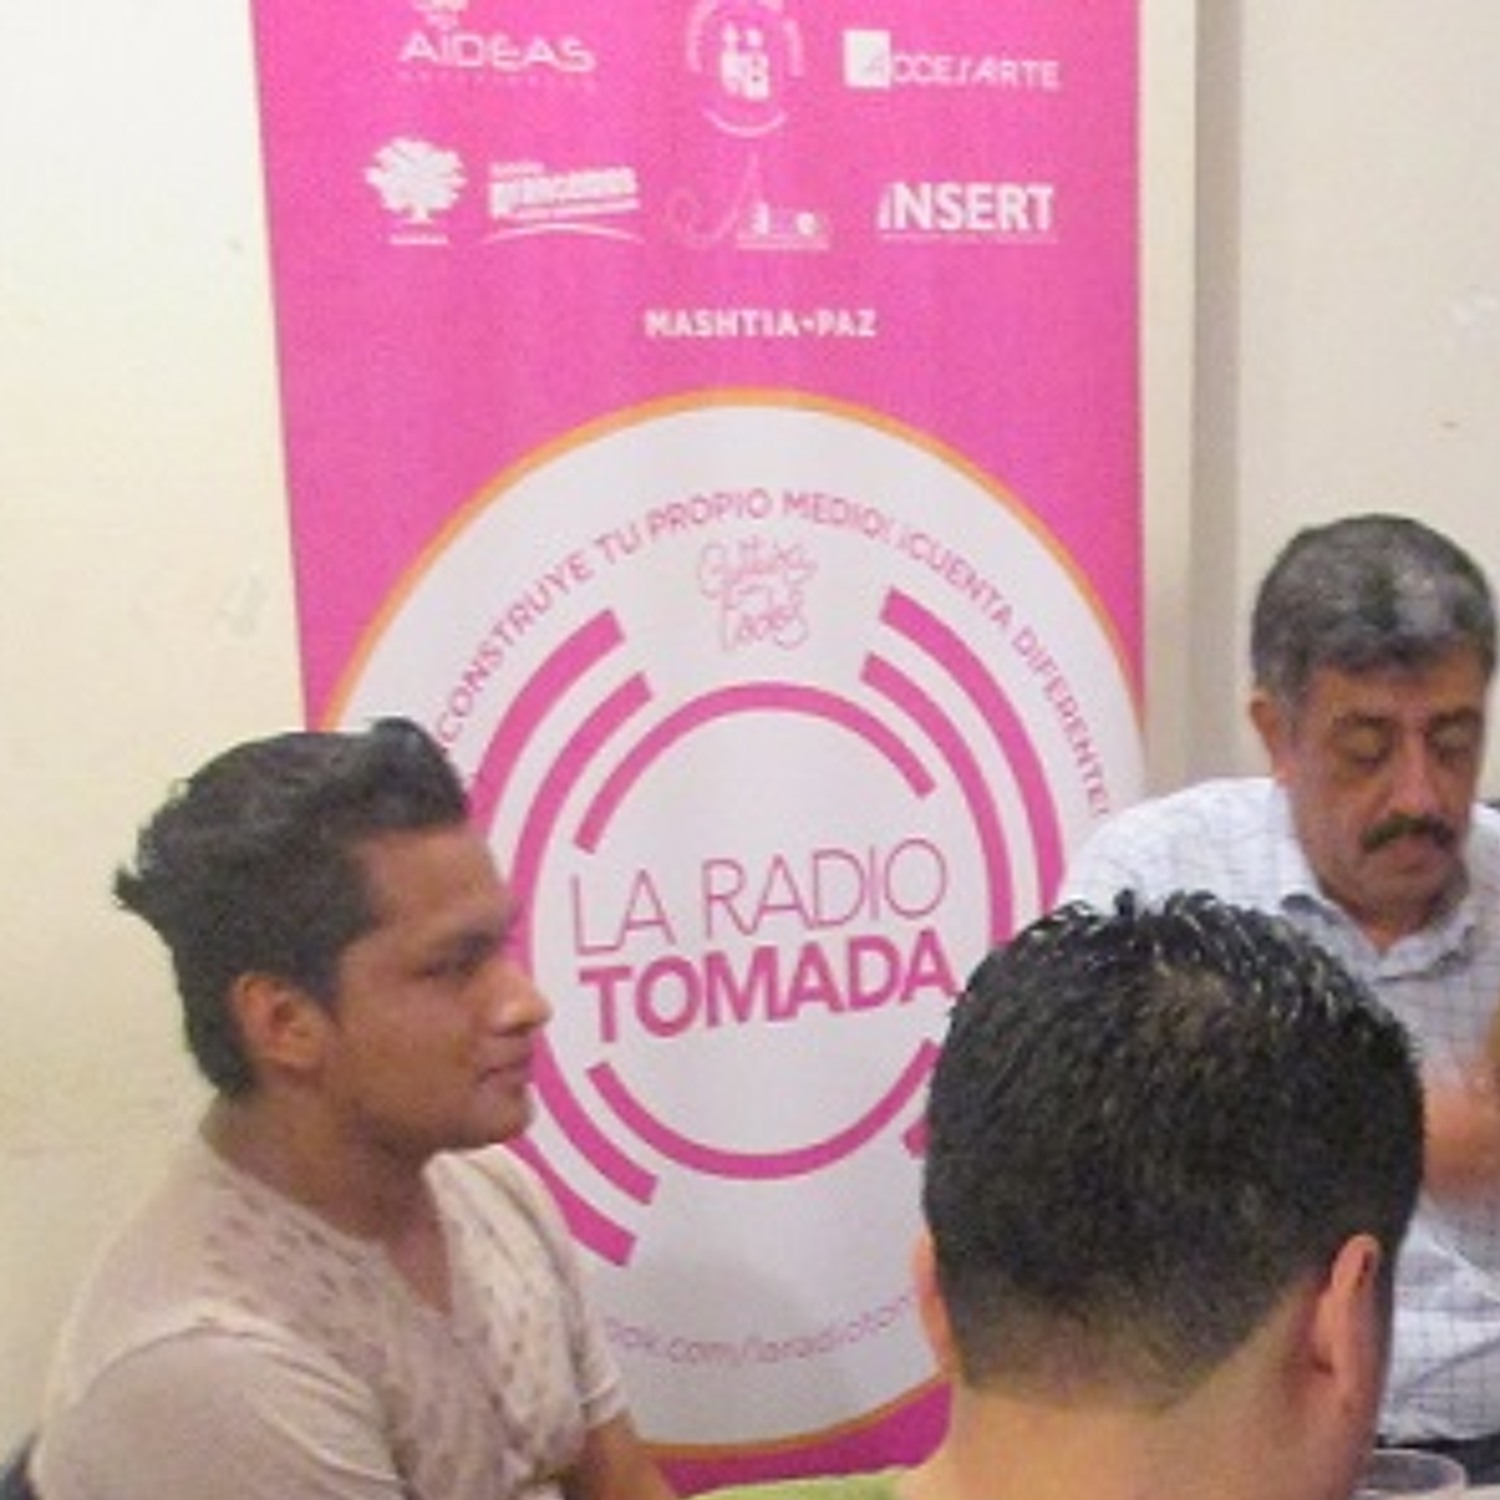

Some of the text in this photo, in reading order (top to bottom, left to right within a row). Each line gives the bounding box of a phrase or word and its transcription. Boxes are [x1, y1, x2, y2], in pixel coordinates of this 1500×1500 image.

[594, 524, 642, 564] TU
[647, 487, 773, 536] PROPIO
[571, 838, 948, 956] LA RADIO
[579, 928, 959, 1044] TOMADA
